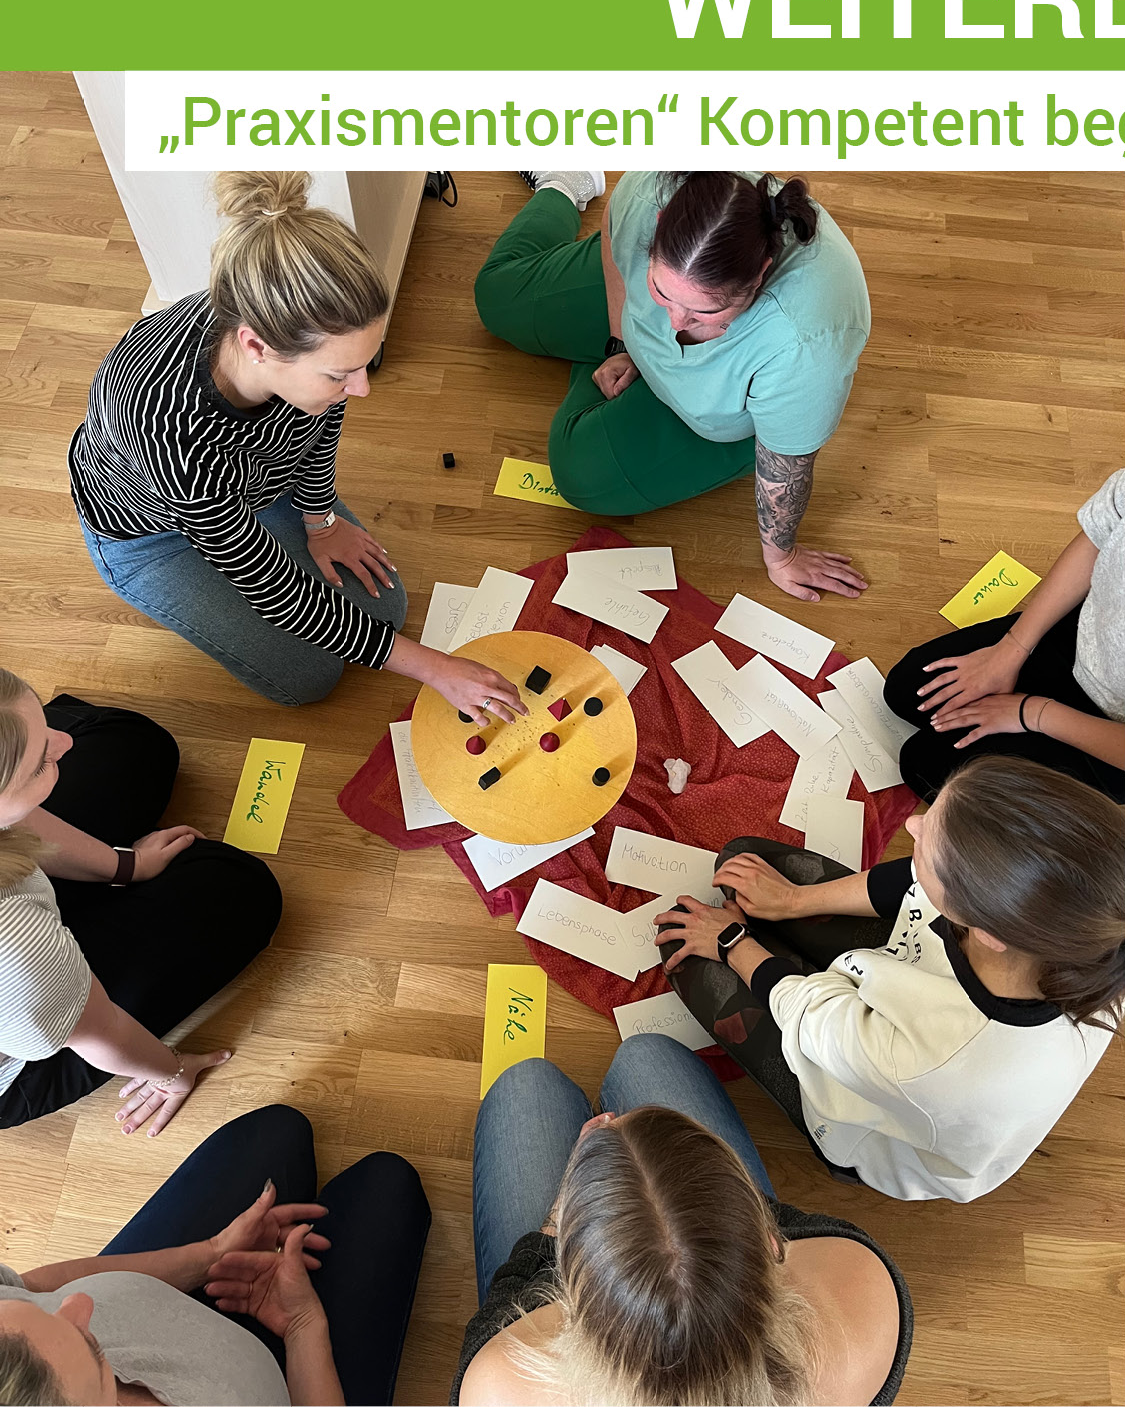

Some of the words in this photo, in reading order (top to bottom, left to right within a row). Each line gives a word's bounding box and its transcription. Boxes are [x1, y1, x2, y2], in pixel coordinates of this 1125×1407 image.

[518, 472, 560, 496] Dista
[973, 568, 1019, 605] Dauer
[444, 597, 468, 635] Stress
[603, 596, 651, 626] Gefühle
[760, 630, 811, 663] Kompetenz
[705, 676, 753, 726] Gender
[765, 689, 817, 738] Nationalität
[846, 714, 883, 773] Sympathie
[246, 760, 287, 824] Wandel
[621, 843, 688, 874] Motivation
[537, 906, 617, 946] Lebensphase
[503, 987, 534, 1046] Nähe
